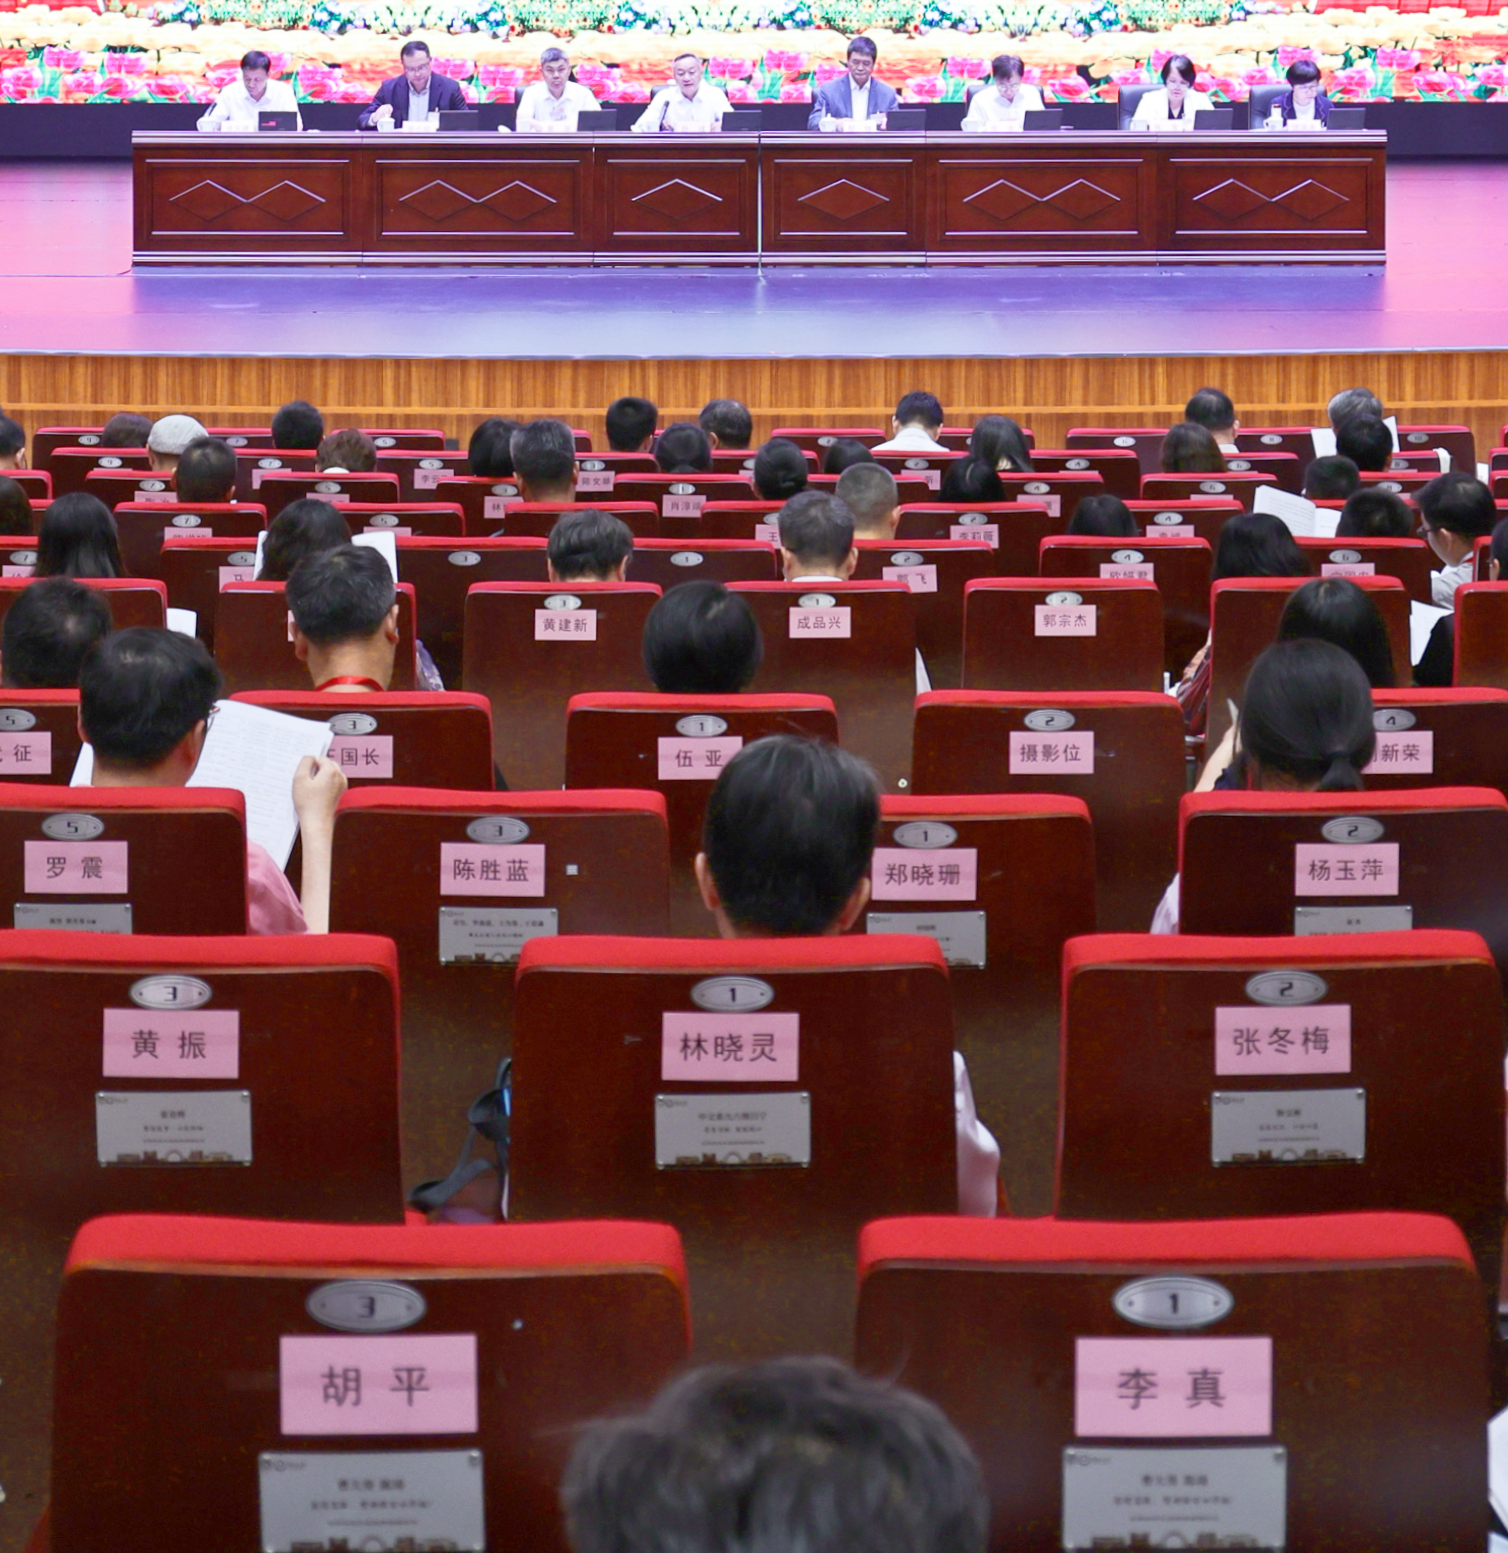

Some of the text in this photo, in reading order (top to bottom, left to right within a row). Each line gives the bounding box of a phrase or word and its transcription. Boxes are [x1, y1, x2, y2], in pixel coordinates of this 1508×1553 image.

[543, 618, 587, 632] 黄建新
[797, 616, 840, 629] 成品兴
[1043, 614, 1086, 627] 郭宗杰
[676, 749, 724, 768] 伍亚
[1020, 744, 1081, 762] 摄影位
[1373, 744, 1421, 763] 新荣
[68, 822, 78, 834] 5
[493, 825, 503, 837] 3
[923, 830, 928, 842] 1
[1348, 825, 1358, 836] 2
[47, 857, 102, 879] 罗震
[453, 859, 528, 881] 陈胜蓝
[885, 864, 960, 885] 郑晓珊
[1309, 859, 1383, 881] 杨玉萍
[164, 986, 178, 1001] 3
[729, 988, 737, 1002] 1
[1279, 982, 1293, 996] 2
[131, 1030, 206, 1059] 黄振
[680, 1033, 776, 1061] 林晓灵
[1233, 1026, 1329, 1055] 张冬梅
[358, 1295, 375, 1319] 3
[1169, 1294, 1179, 1314] 1
[321, 1366, 429, 1406] 胡平
[1117, 1368, 1225, 1409] 李真
